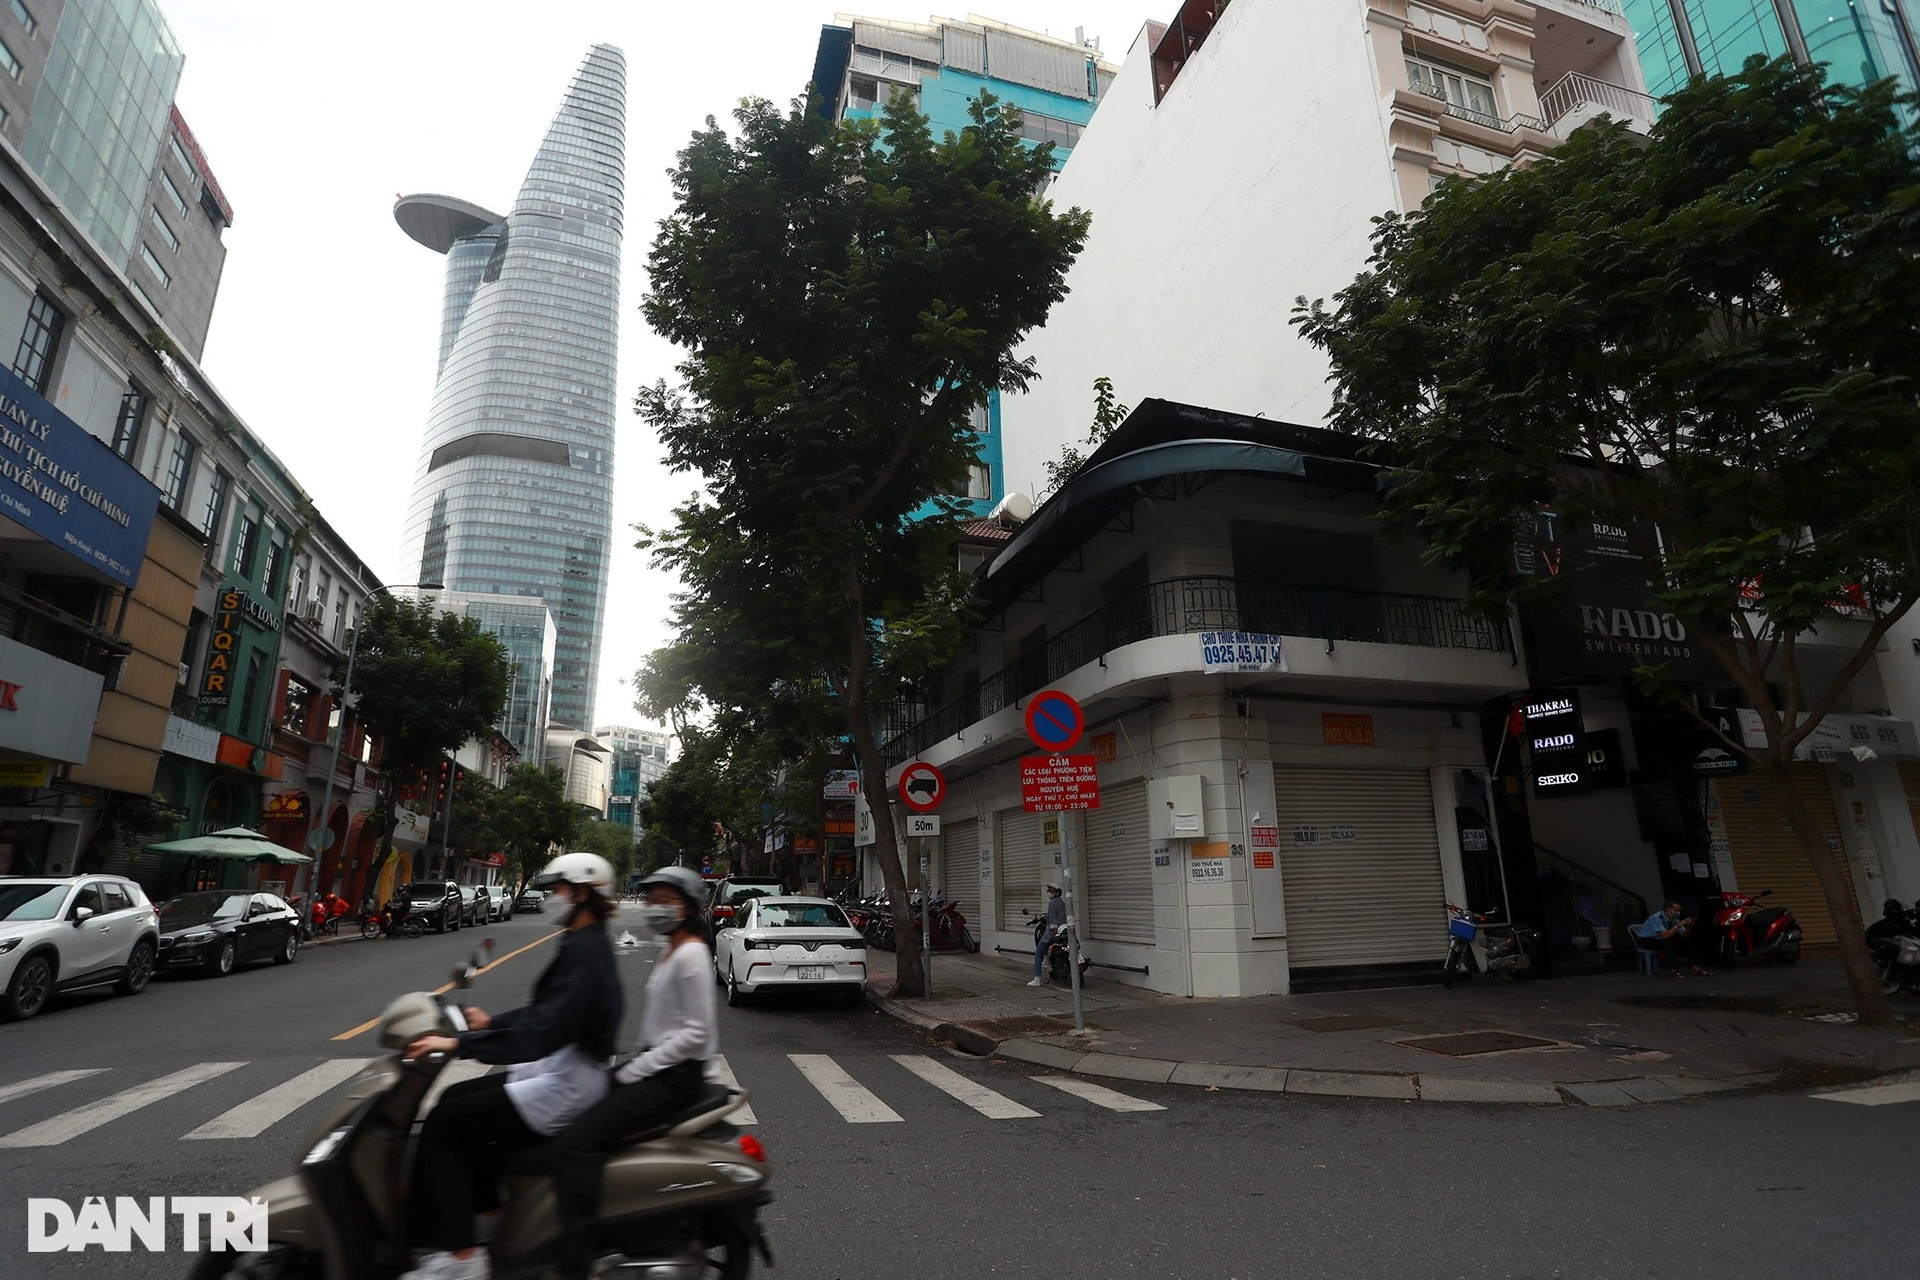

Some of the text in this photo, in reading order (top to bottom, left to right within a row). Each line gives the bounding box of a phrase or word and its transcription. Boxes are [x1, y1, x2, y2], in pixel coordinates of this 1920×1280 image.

[29, 419, 51, 442] LÝ
[25, 444, 59, 479] TỊCH
[59, 469, 80, 492] HỒ
[80, 484, 102, 508] CHÍ
[101, 499, 131, 528] MINH
[40, 486, 69, 516] HUỆ
[257, 606, 280, 631] LONG
[1578, 604, 1687, 642] RADO
[1201, 632, 1216, 646] CHO
[1585, 639, 1691, 658] SWITZERLAND
[198, 696, 228, 705] LOUNGE
[1526, 699, 1573, 714] THAKRAL
[1534, 734, 1574, 748] RADO
[1049, 755, 1069, 766] CẤM
[1024, 767, 1036, 775] CÁC
[1038, 767, 1051, 776] LOẠI
[1079, 765, 1093, 773] TIỆN
[1037, 775, 1057, 784] THÔNG
[1058, 775, 1074, 783] TRÊN
[1537, 772, 1579, 786] SEIKO
[1040, 783, 1079, 793] NGUYỄN HUỆ
[1065, 792, 1078, 800] CHỦ
[1080, 791, 1096, 800] NHẬT
[1035, 801, 1043, 811] TỪ
[860, 811, 869, 832] 30
[915, 820, 933, 831] 50m
[1231, 844, 1243, 856] 33
